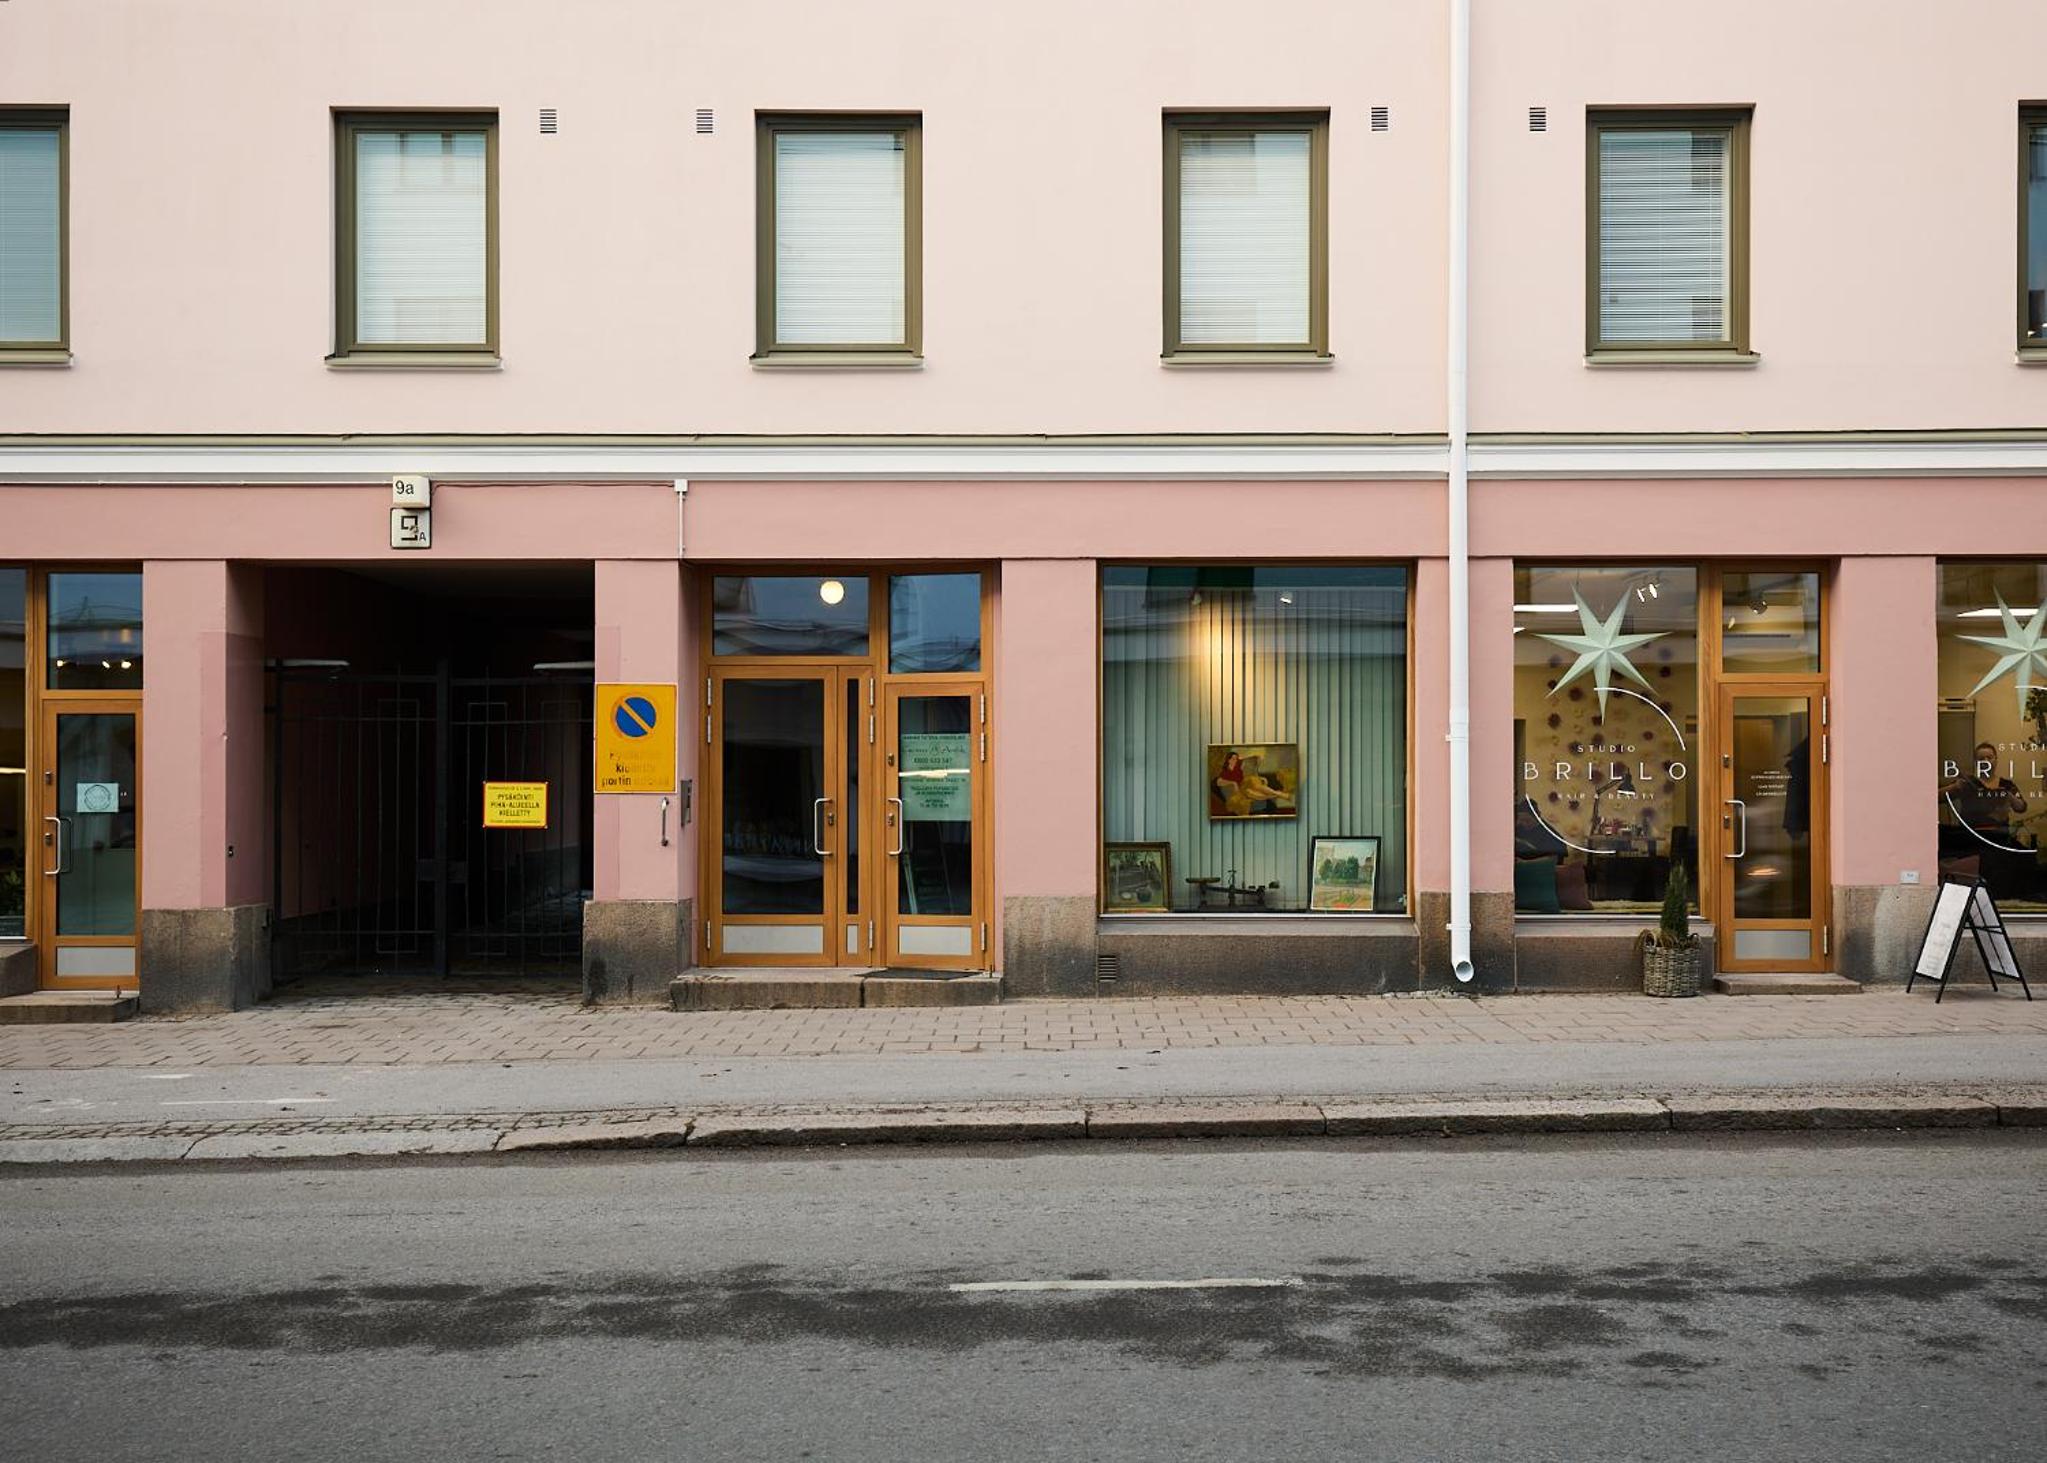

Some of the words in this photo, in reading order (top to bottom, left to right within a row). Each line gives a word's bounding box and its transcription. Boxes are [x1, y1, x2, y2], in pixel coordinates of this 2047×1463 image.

[395, 480, 414, 494] 9a
[1577, 744, 1637, 753] STUDIO
[1998, 743, 2045, 751] STUDI
[1523, 762, 1687, 781] BRILLO
[1944, 760, 2045, 779] BRIL
